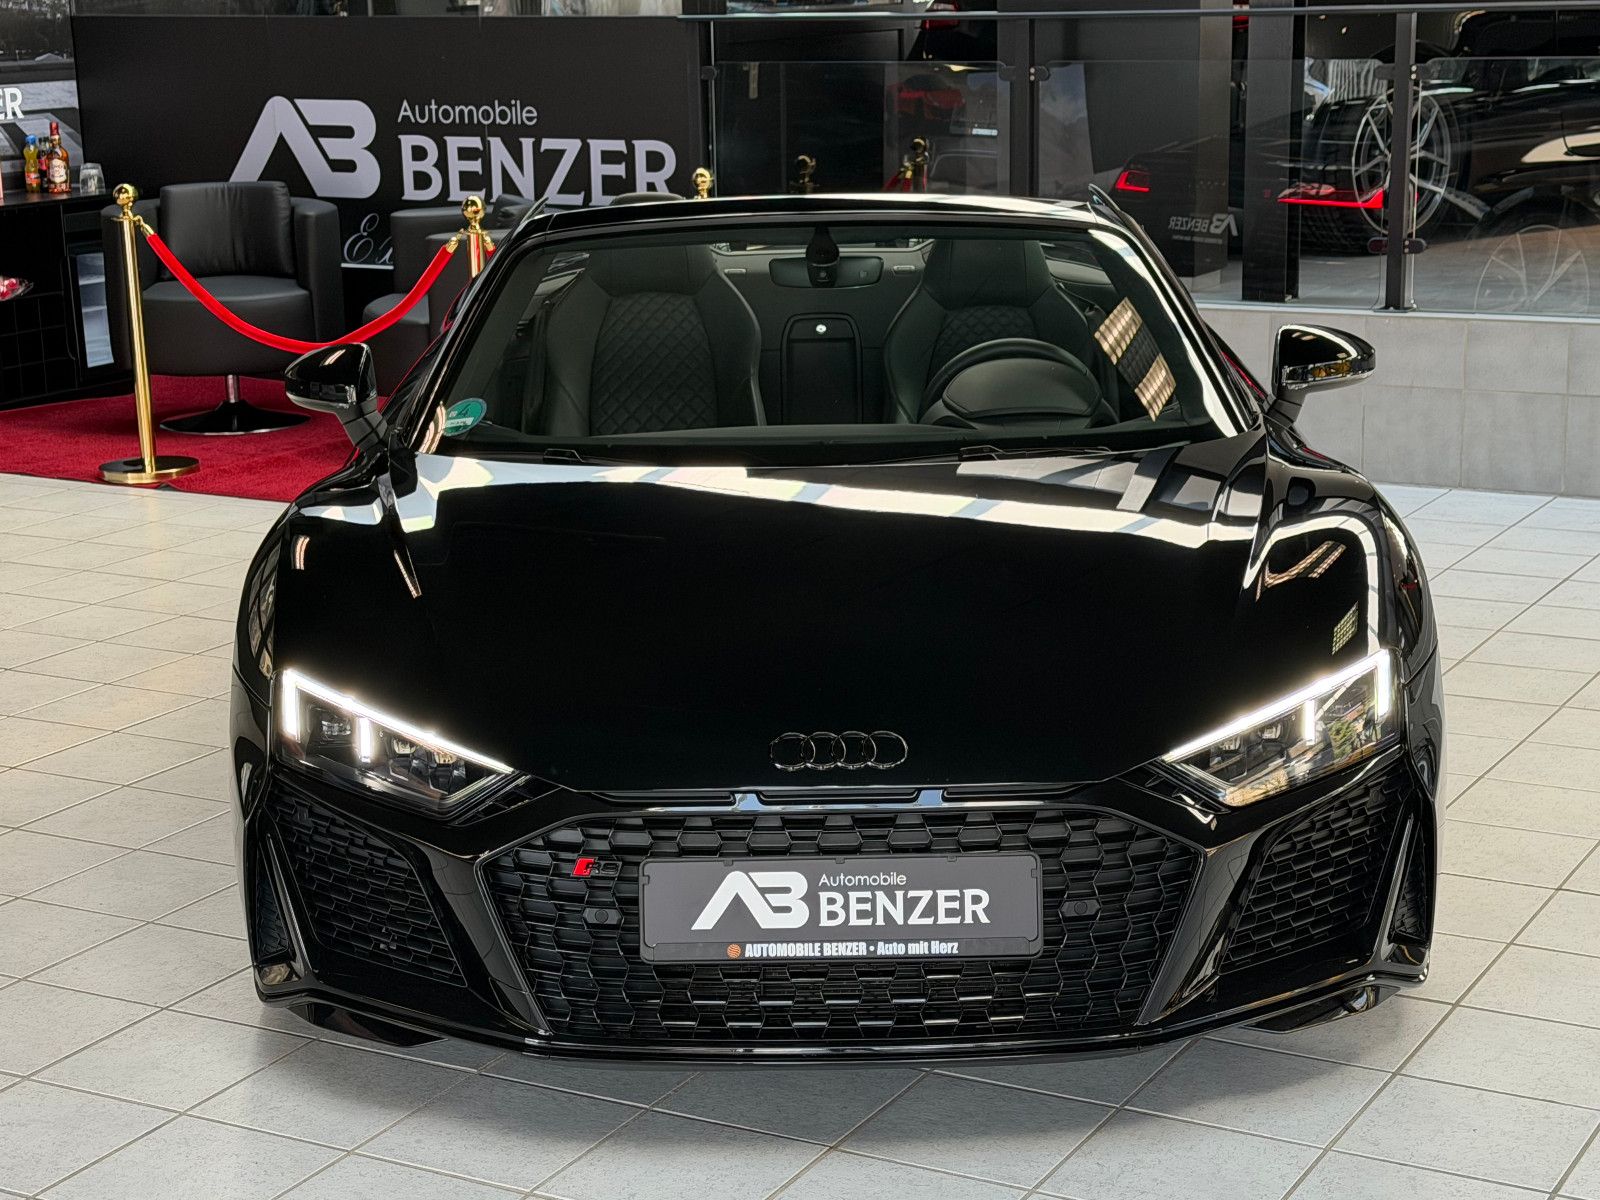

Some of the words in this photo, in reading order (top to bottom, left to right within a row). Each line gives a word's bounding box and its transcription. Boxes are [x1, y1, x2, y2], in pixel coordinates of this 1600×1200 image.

[0, 87, 25, 119] R
[397, 99, 538, 126] Automobile
[398, 134, 677, 207] BENZER
[818, 871, 907, 887] Automobile
[818, 888, 991, 927] BENZER
[744, 943, 821, 958] AUTOMOBILE
[823, 942, 867, 957] BENZER
[877, 941, 905, 955] Auto
[907, 941, 929, 955] mit
[931, 940, 959, 955] Herz
